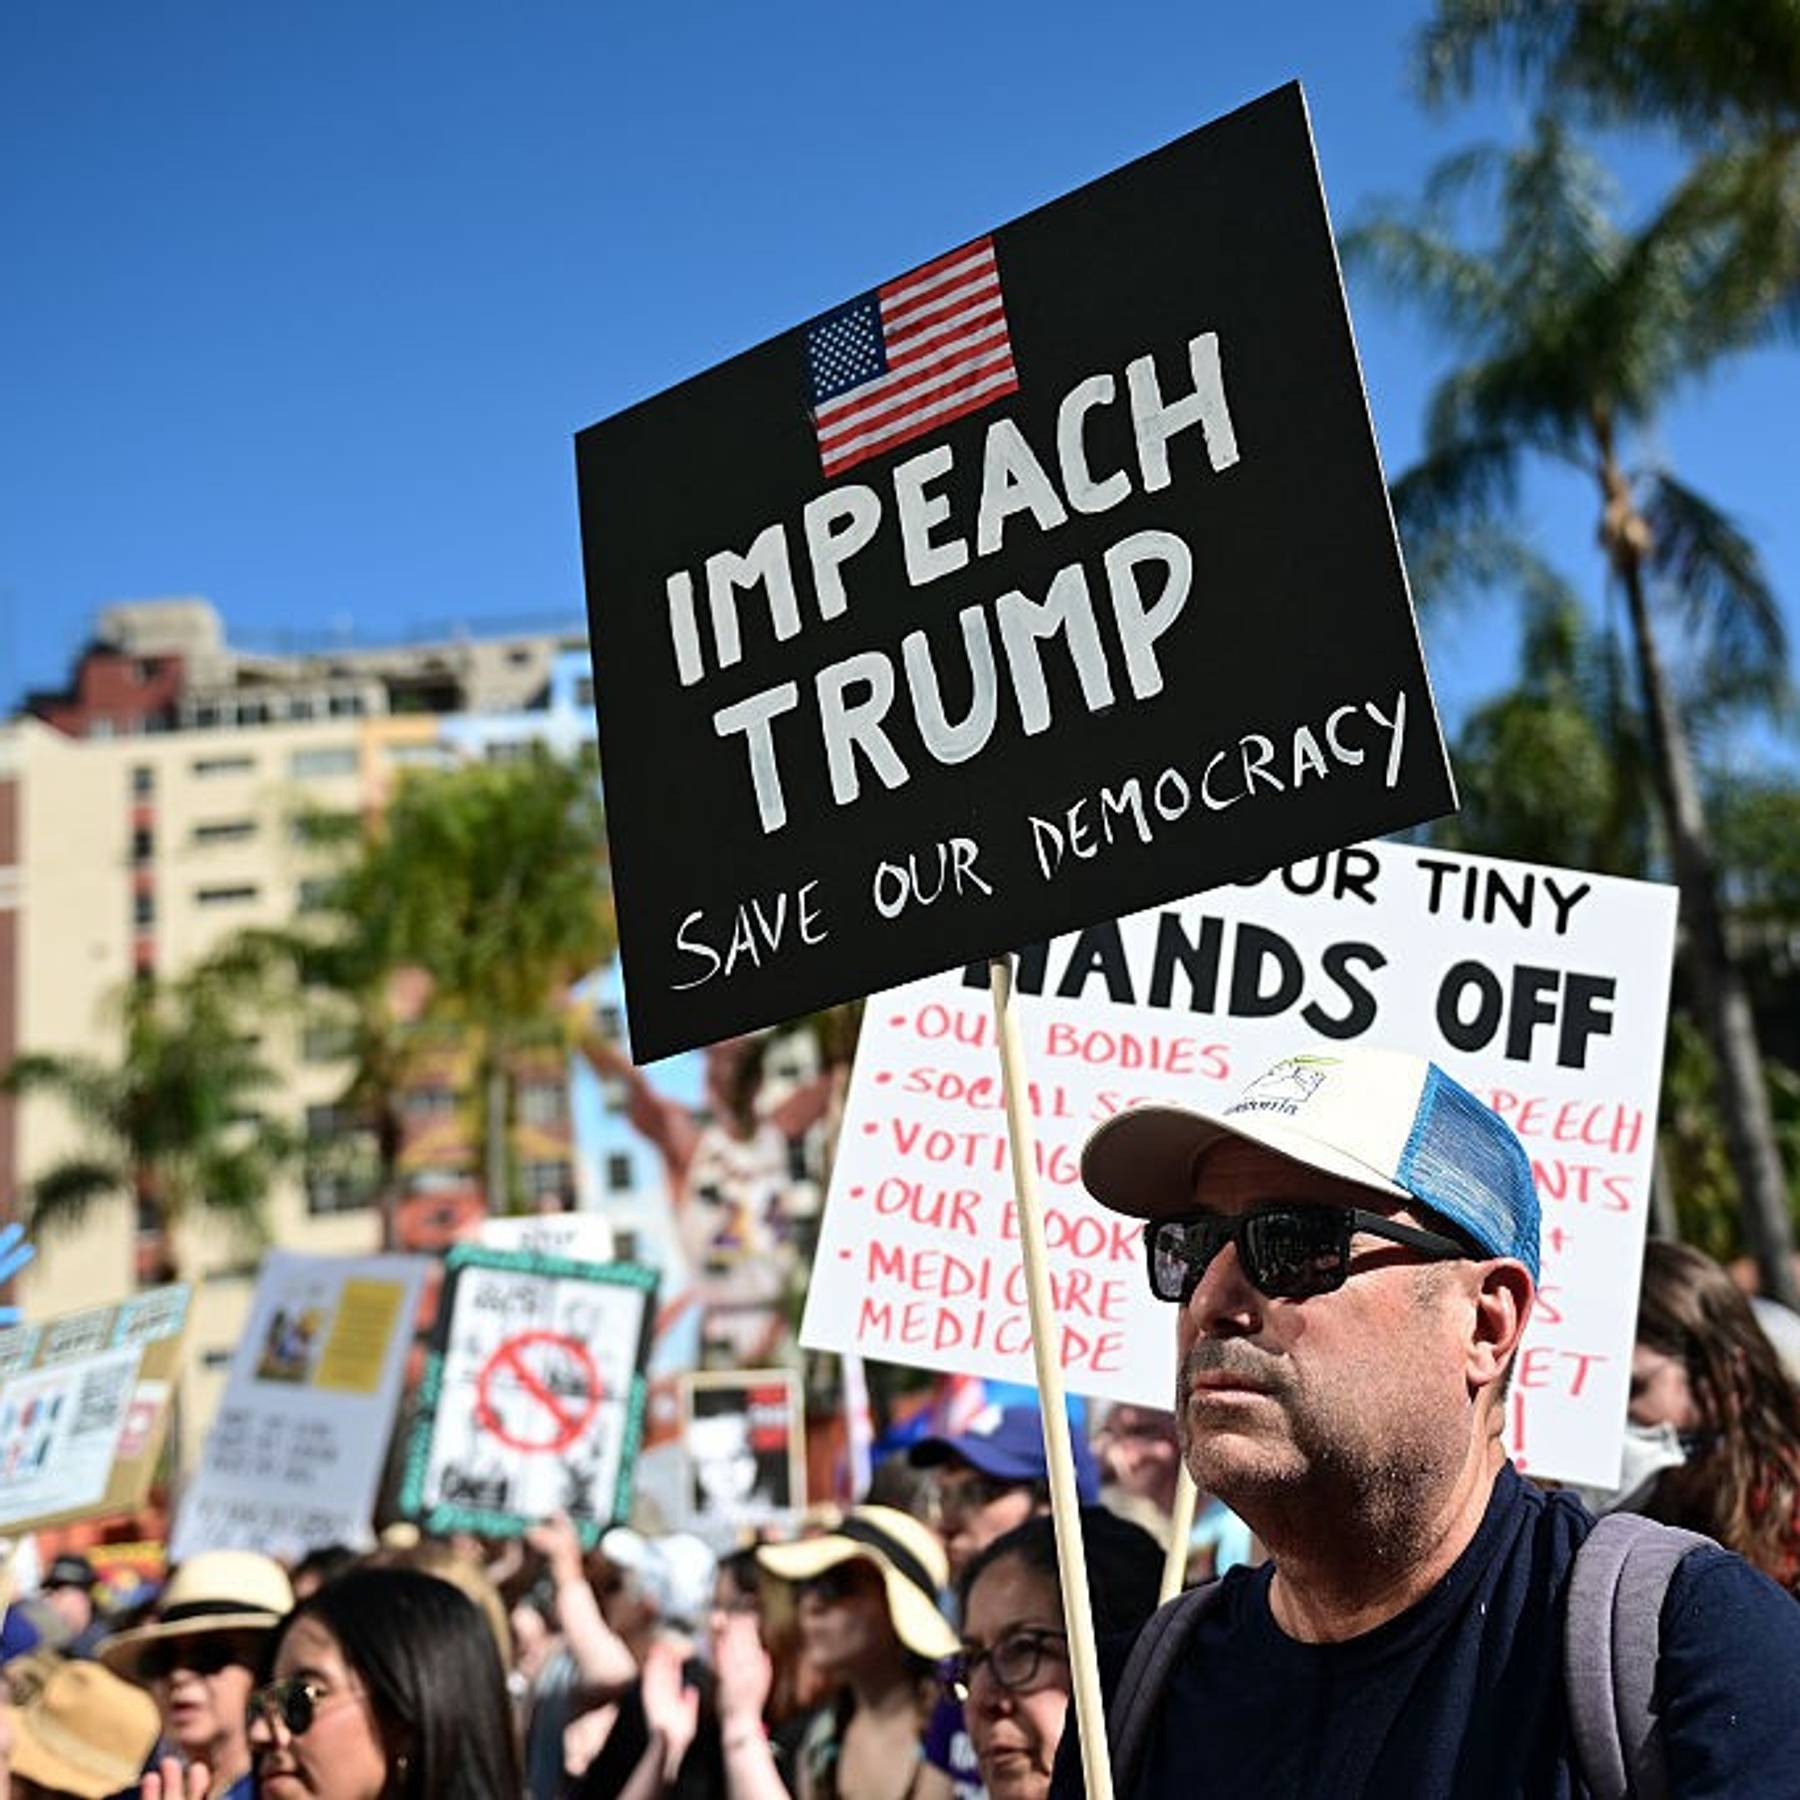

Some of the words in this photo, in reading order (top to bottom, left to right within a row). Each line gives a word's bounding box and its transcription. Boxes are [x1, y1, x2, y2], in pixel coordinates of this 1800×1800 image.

[665, 330, 1241, 688] IMPEACH
[713, 529, 1194, 835] TRUMP
[670, 879, 829, 991] SAVE
[872, 837, 993, 919] OUR
[1027, 690, 1407, 881] DEMOCRACY
[1236, 847, 1380, 905] UR
[1415, 858, 1592, 936] TINY
[914, 1003, 1000, 1048] OU
[1045, 1022, 1231, 1081] BODIES
[1436, 960, 1617, 1070] OFF
[1483, 1087, 1644, 1155] PEECH
[873, 1176, 982, 1237] OUR
[1531, 1158, 1635, 1214] NTS
[1517, 1345, 1609, 1398] ET
